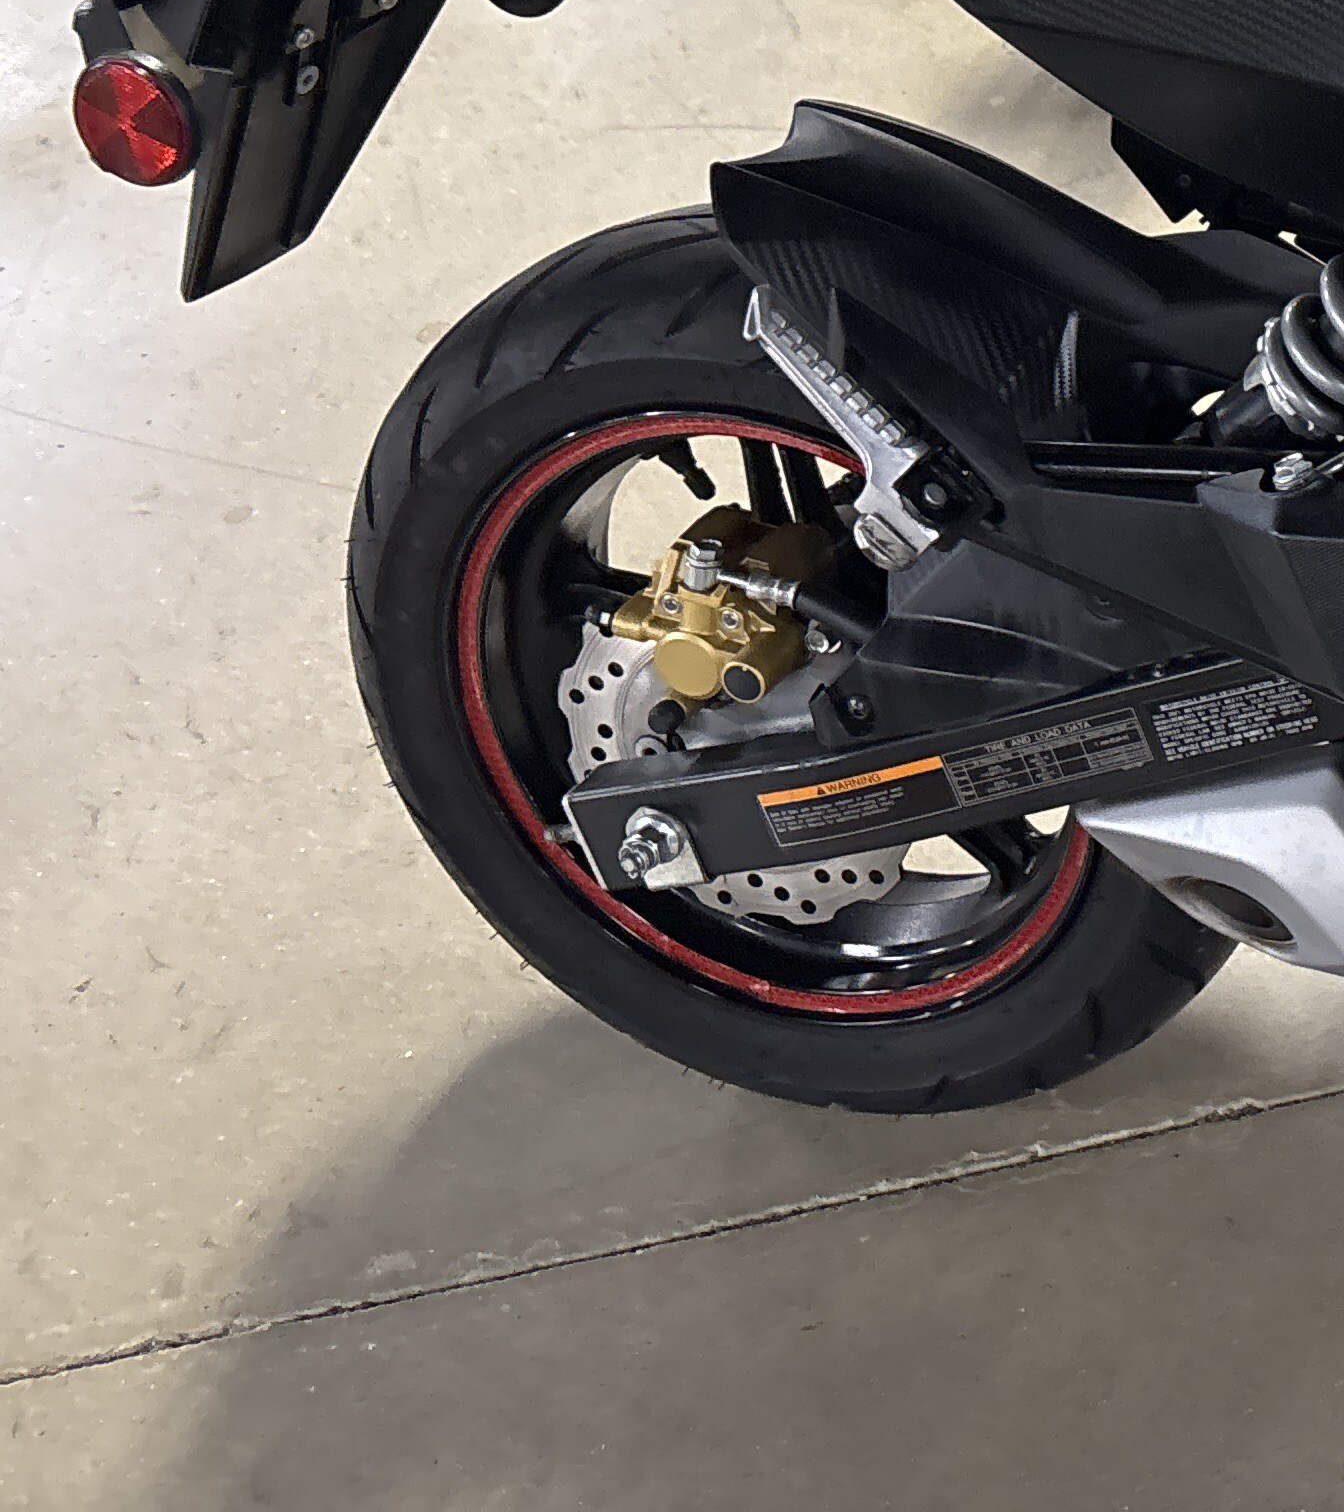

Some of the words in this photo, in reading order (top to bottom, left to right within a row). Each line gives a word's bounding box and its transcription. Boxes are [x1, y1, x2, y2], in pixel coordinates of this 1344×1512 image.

[1010, 735, 1032, 747] AND
[1033, 727, 1062, 740] LOAD
[1064, 721, 1092, 733] DATA
[825, 773, 882, 794] WARNING
